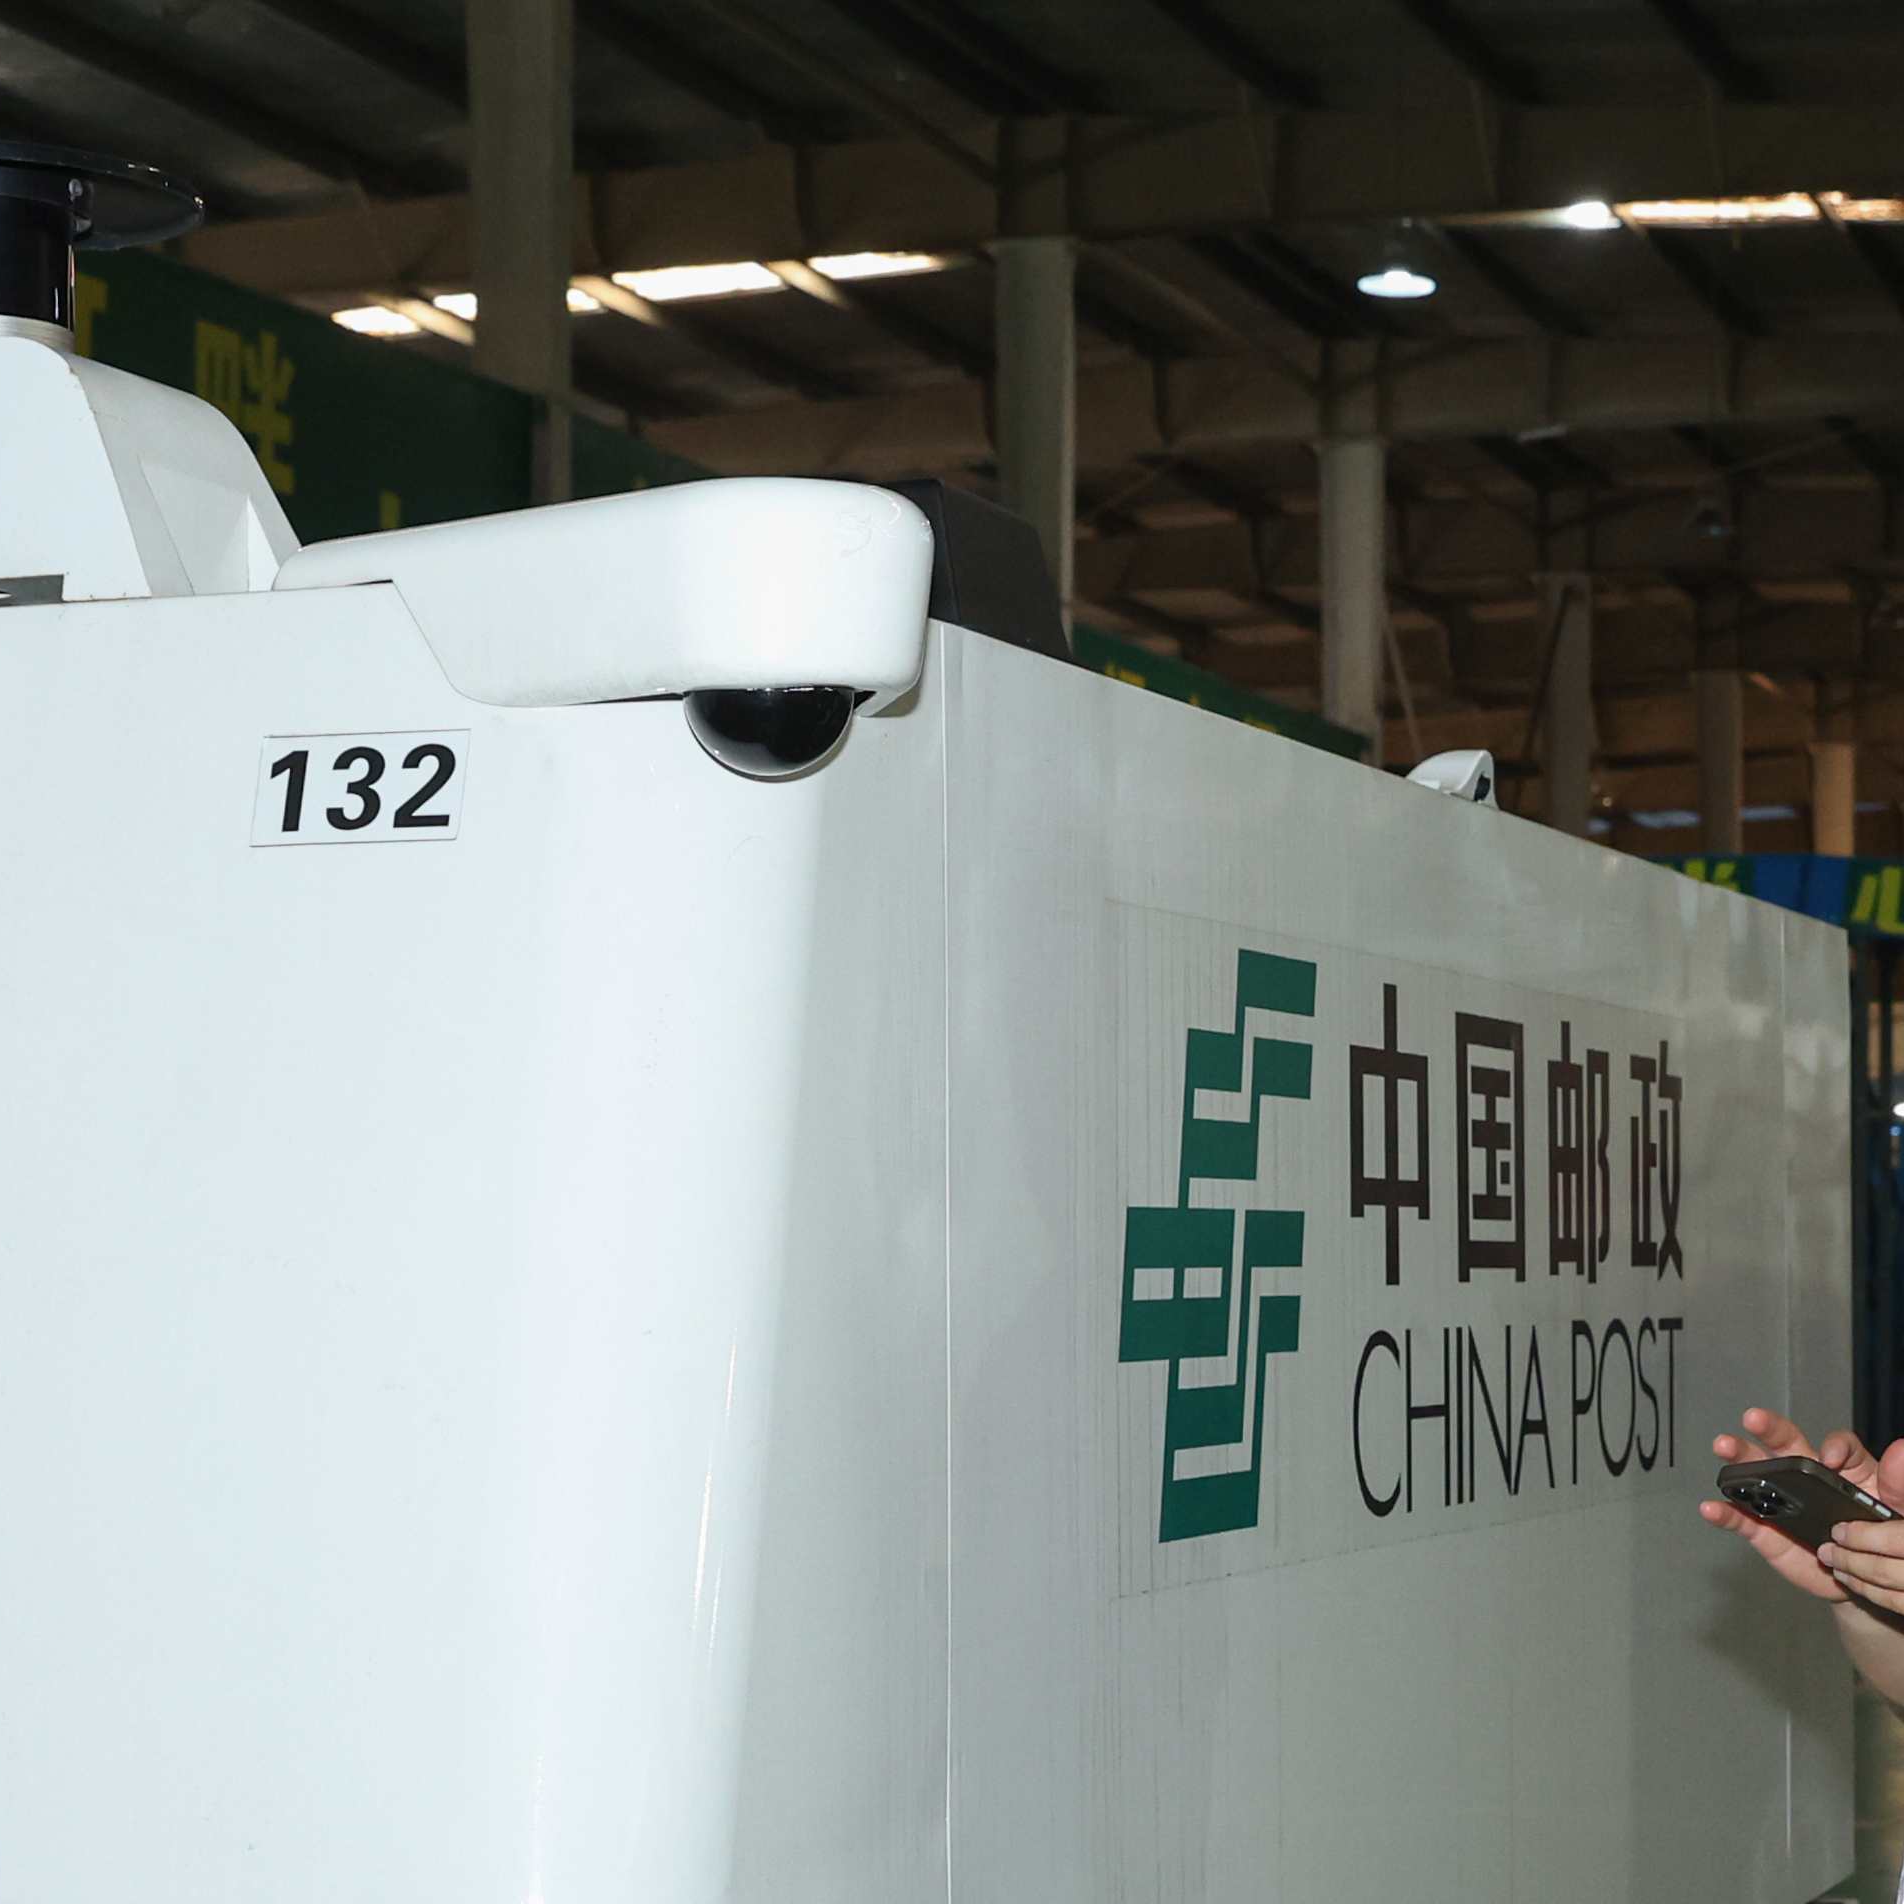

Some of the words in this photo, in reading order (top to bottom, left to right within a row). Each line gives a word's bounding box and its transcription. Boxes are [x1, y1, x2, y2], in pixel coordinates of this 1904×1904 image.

[265, 743, 457, 833] 132
[1349, 982, 1684, 1286] 中国邮政
[1353, 1323, 1556, 1518] CHINA
[1570, 1317, 1684, 1486] POST
